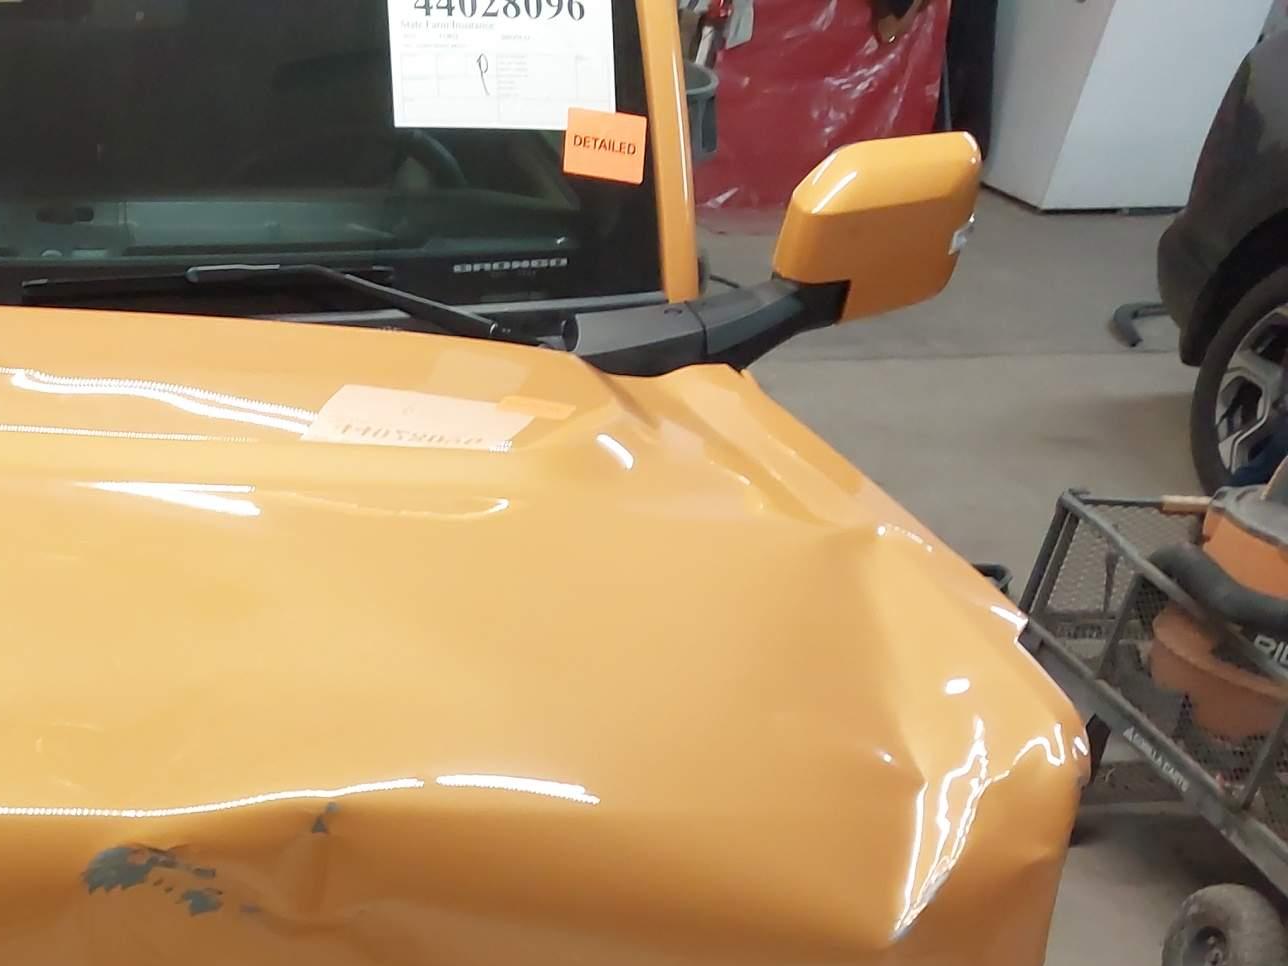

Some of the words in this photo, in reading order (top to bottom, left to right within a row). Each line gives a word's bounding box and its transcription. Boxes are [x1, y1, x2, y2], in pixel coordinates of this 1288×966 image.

[414, 0, 585, 21] 44028096
[573, 134, 637, 155] DETAILED
[453, 258, 568, 273] BRONCO
